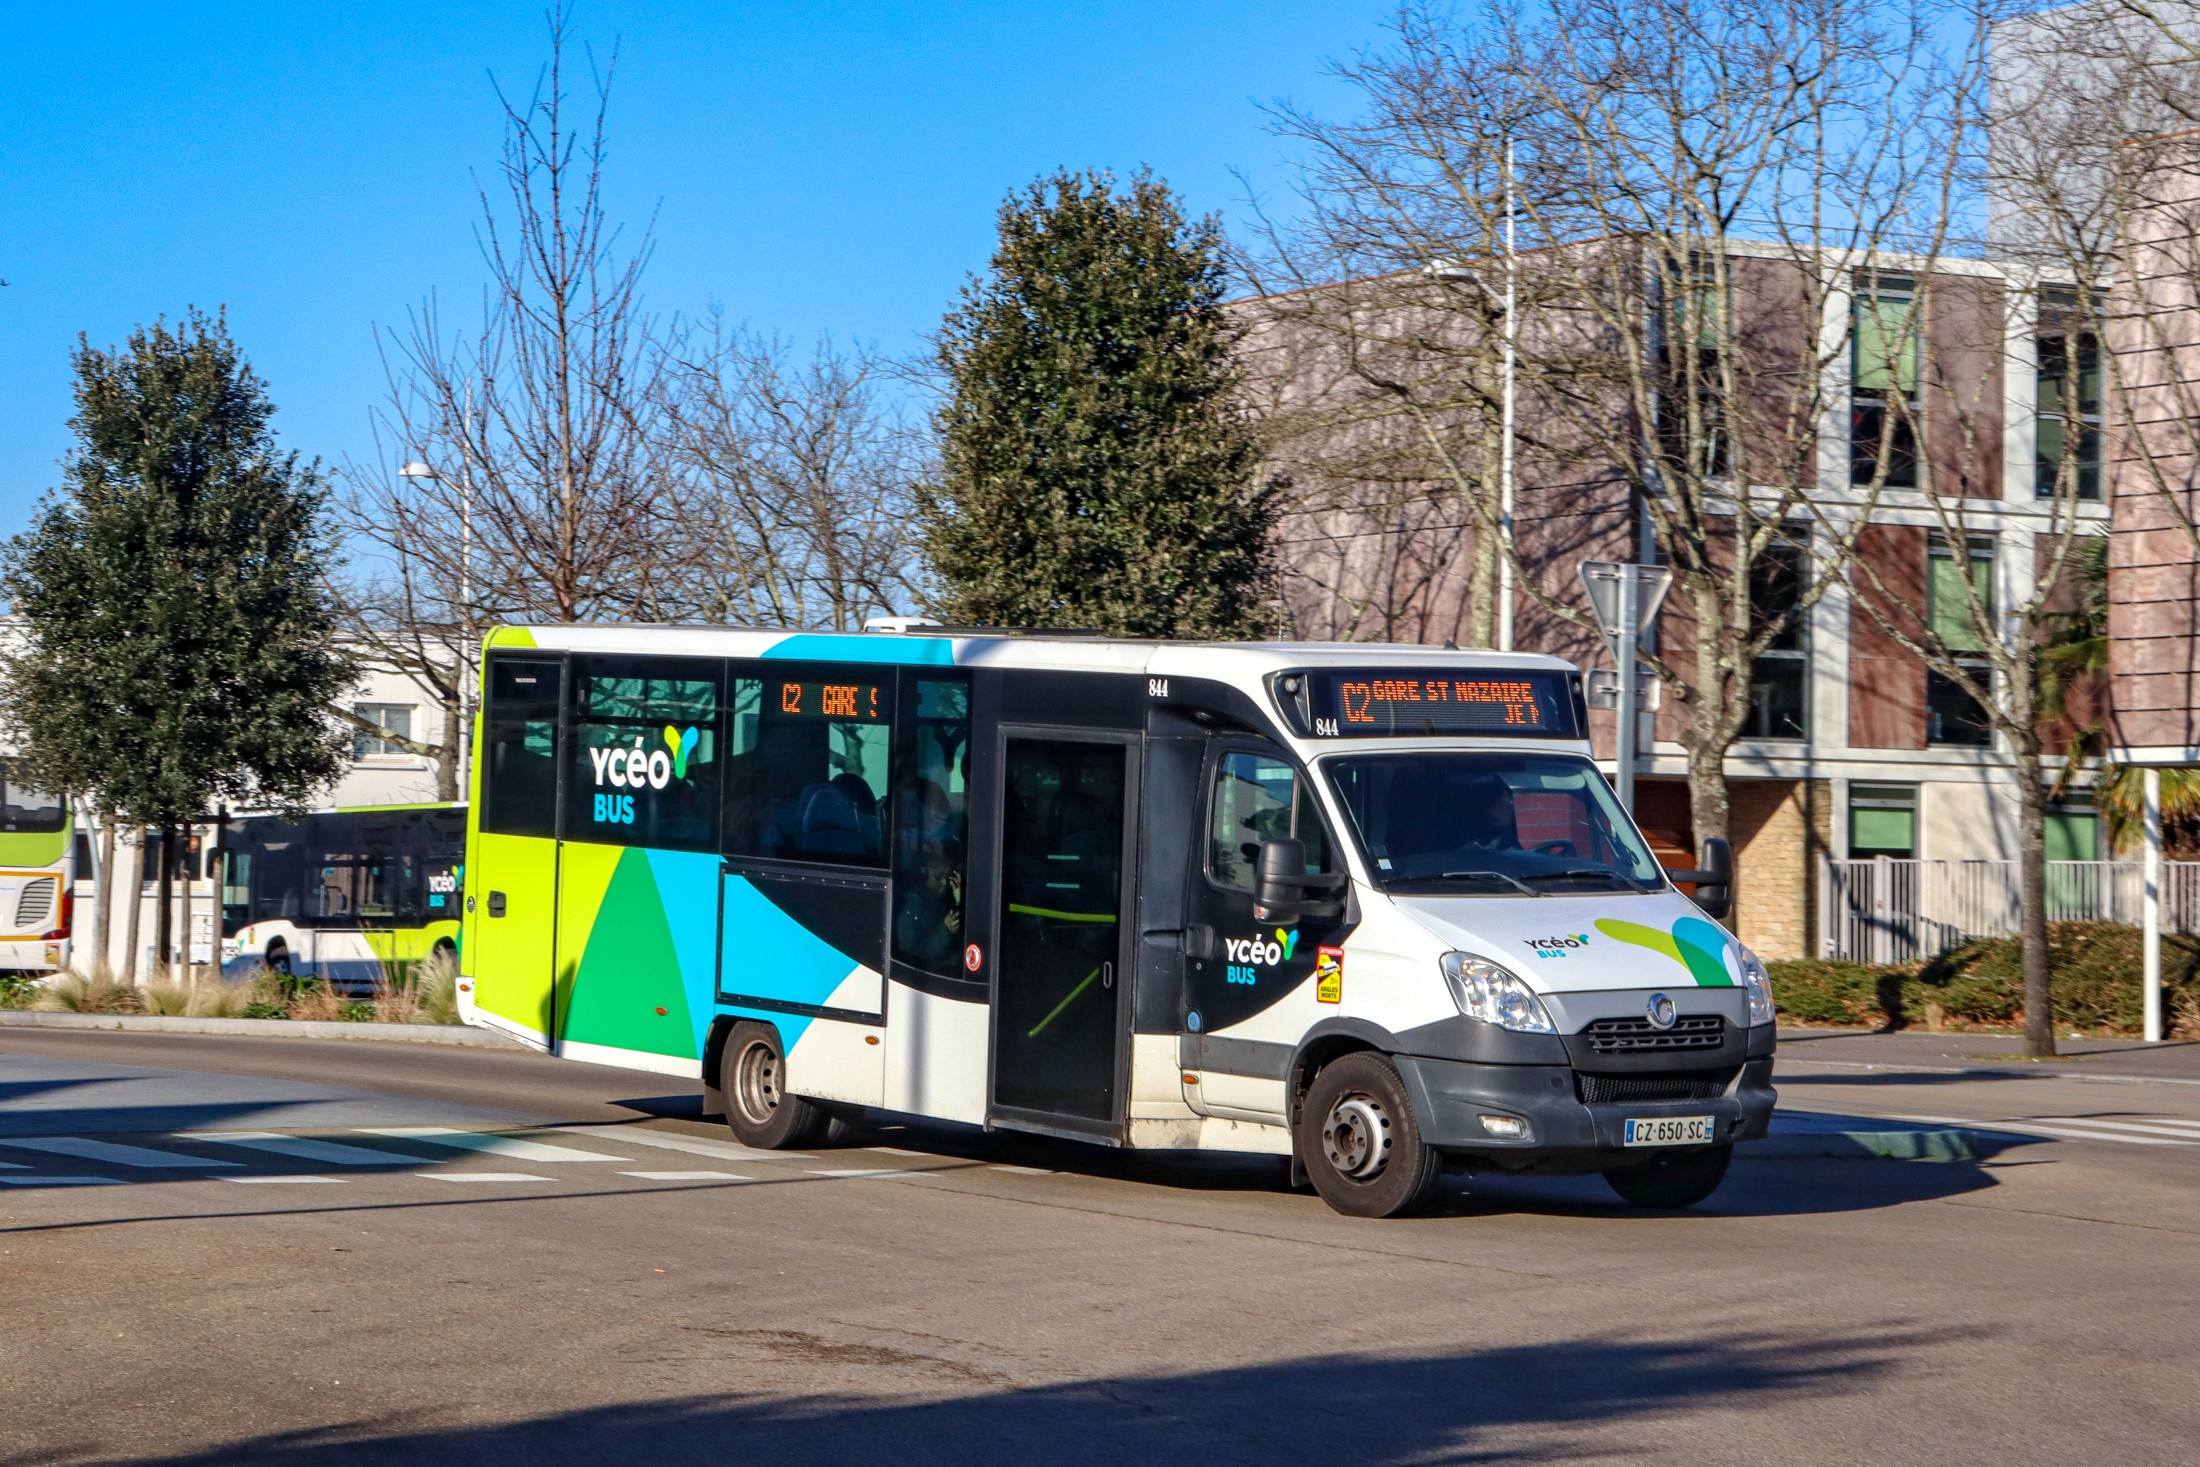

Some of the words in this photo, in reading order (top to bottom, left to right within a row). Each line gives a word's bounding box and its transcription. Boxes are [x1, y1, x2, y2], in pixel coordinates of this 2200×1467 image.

[1149, 678, 1169, 697] 844
[782, 683, 802, 713] C2
[822, 685, 859, 716] GARE
[1342, 682, 1375, 722] C2
[1372, 680, 1421, 701] GARE
[1425, 681, 1449, 701] ST
[1455, 681, 1534, 702] NAZAIRE
[1315, 717, 1340, 736] 844
[593, 793, 635, 825] BUS
[430, 894, 445, 907] BUS
[1536, 949, 1567, 959] BUS
[1227, 965, 1256, 985] BUS
